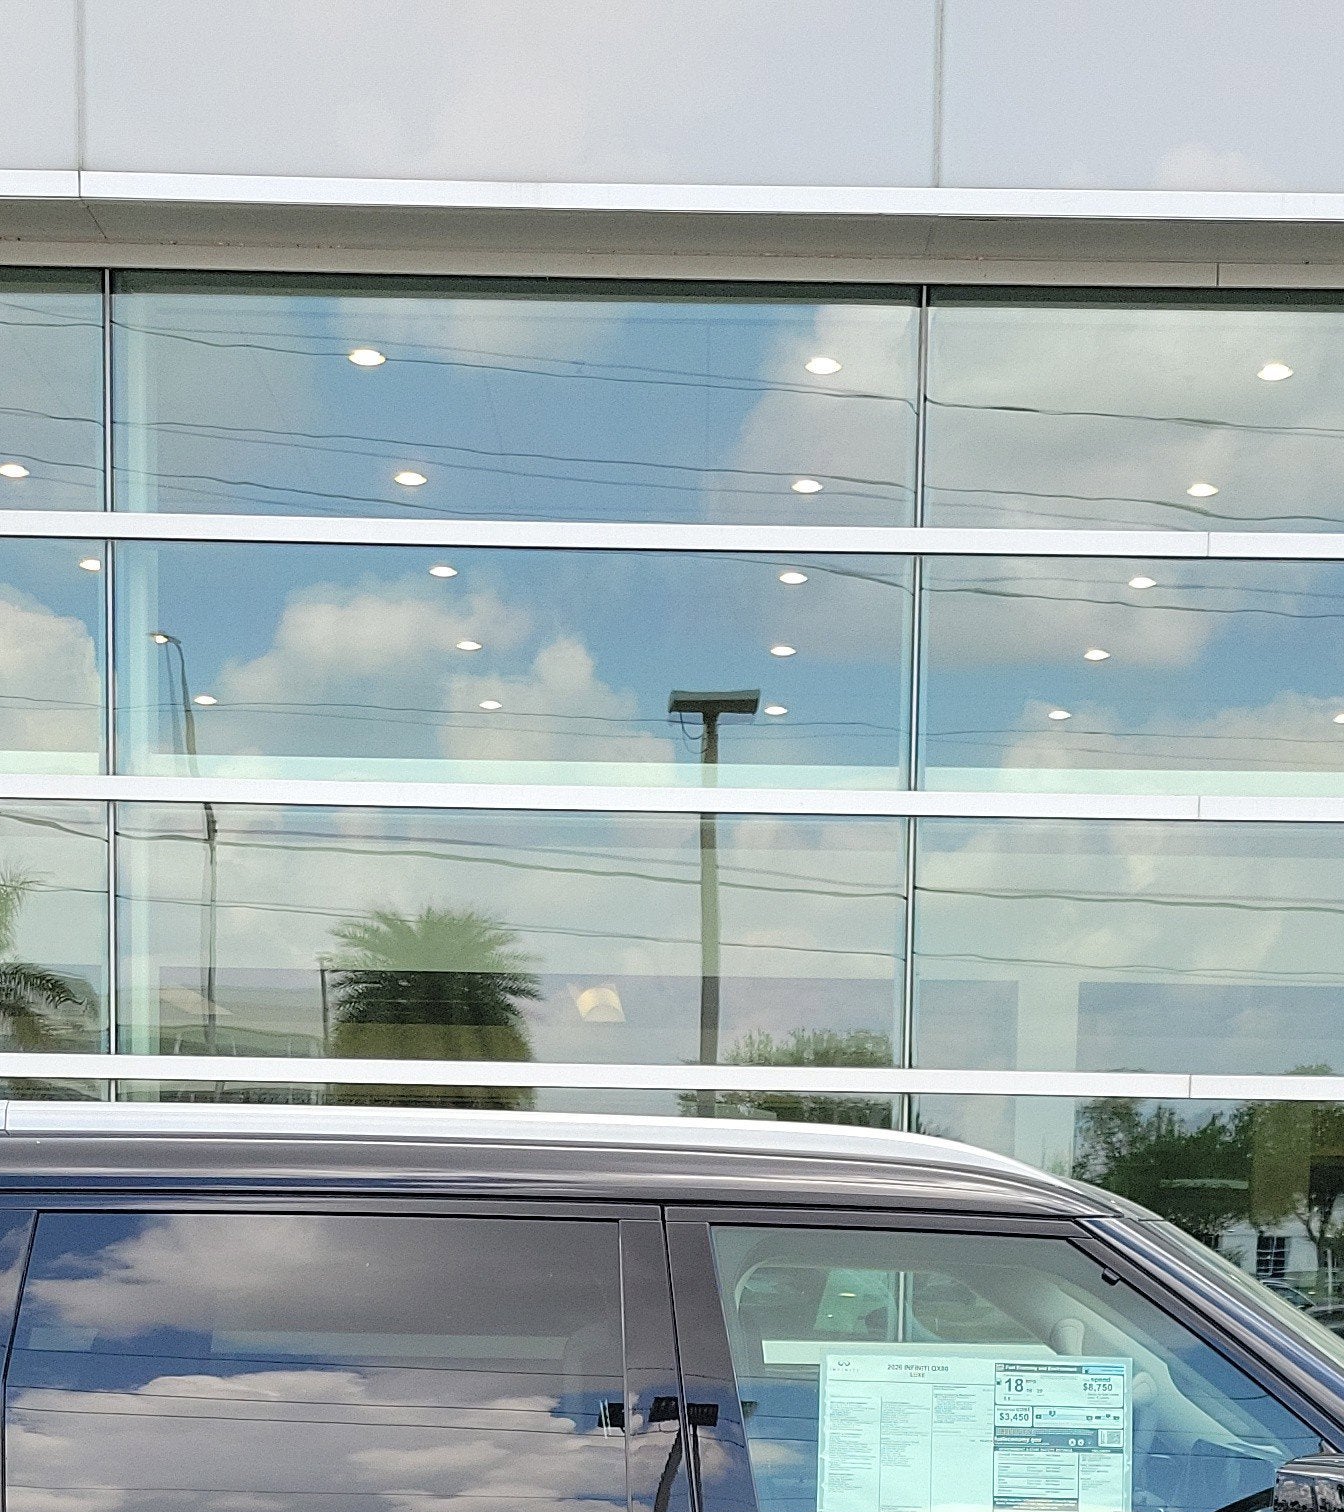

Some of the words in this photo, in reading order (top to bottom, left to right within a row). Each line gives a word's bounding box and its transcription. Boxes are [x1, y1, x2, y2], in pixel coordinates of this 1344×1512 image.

[1004, 1377, 1024, 1392] 18
[1083, 1383, 1113, 1392] $8,750
[999, 1412, 1029, 1422] $3,450
